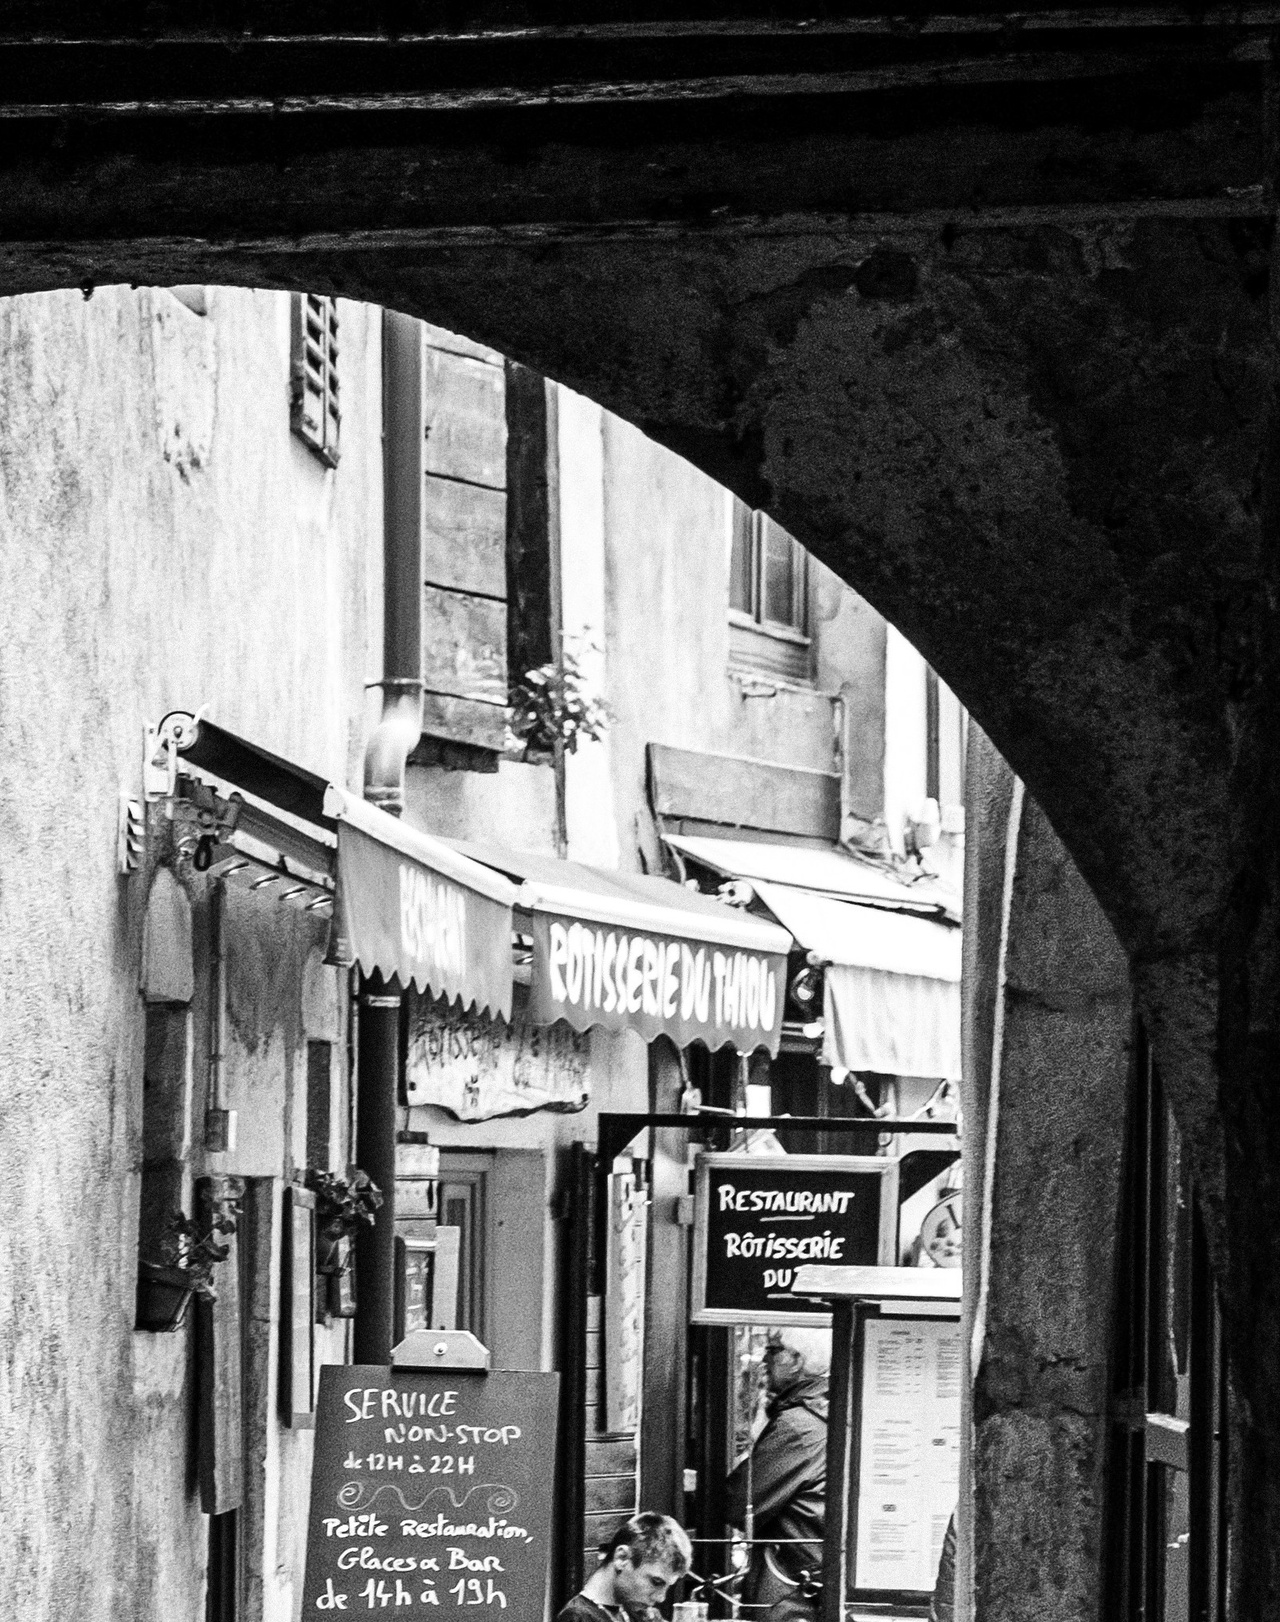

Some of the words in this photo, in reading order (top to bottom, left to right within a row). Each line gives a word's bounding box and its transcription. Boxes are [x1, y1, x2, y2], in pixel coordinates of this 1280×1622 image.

[681, 943, 711, 1023] DU
[714, 951, 776, 1032] THIOU
[718, 1184, 855, 1214] RESTAURANT
[763, 1269, 792, 1288] DU
[343, 1388, 459, 1423] SERVICE
[384, 1423, 521, 1446] NON-STOP
[343, 1451, 363, 1469] de
[367, 1453, 404, 1471] 12H
[429, 1455, 475, 1475] 22H
[322, 1513, 389, 1538] Petite
[337, 1546, 418, 1572] Glaces
[316, 1577, 349, 1610] de
[359, 1578, 412, 1609] 14h
[420, 1579, 440, 1606] à
[449, 1578, 508, 1609] 19h
